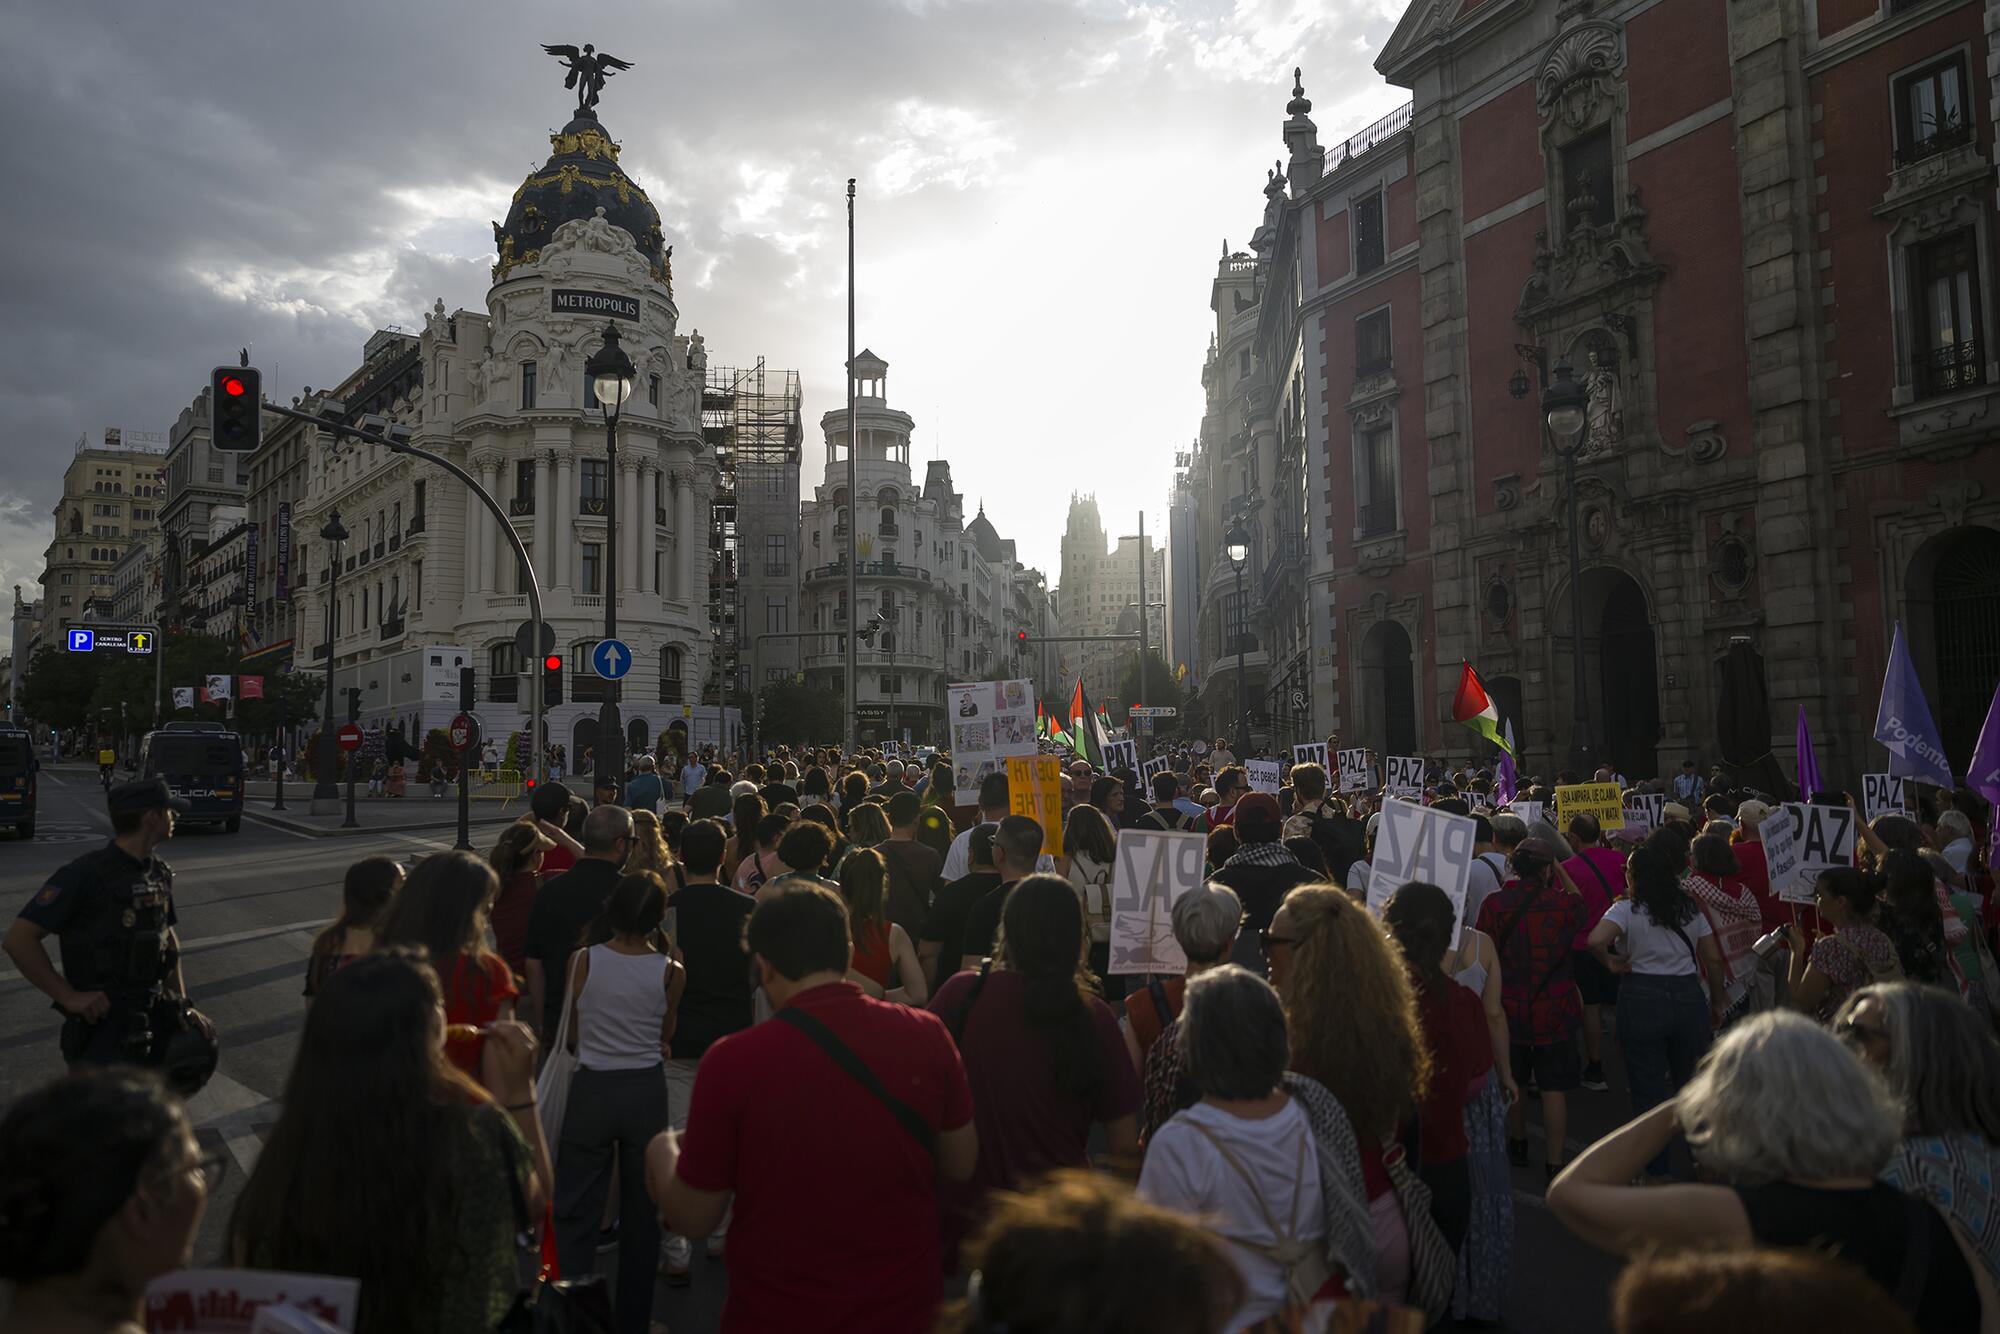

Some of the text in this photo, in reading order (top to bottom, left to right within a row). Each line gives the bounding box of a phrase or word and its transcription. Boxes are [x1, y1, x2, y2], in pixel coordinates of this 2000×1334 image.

[557, 294, 637, 316] METROPOLIS
[247, 546, 257, 612] POR SER MUJERES
[75, 633, 88, 648] P
[1104, 742, 1136, 774] PAZ
[1884, 716, 1953, 774] Podemo
[1339, 750, 1367, 775] PAZ
[1387, 758, 1423, 787] PAZ
[1866, 776, 1903, 809] PAZ
[1562, 810, 1567, 824] E
[1787, 806, 1852, 866] PAZ
